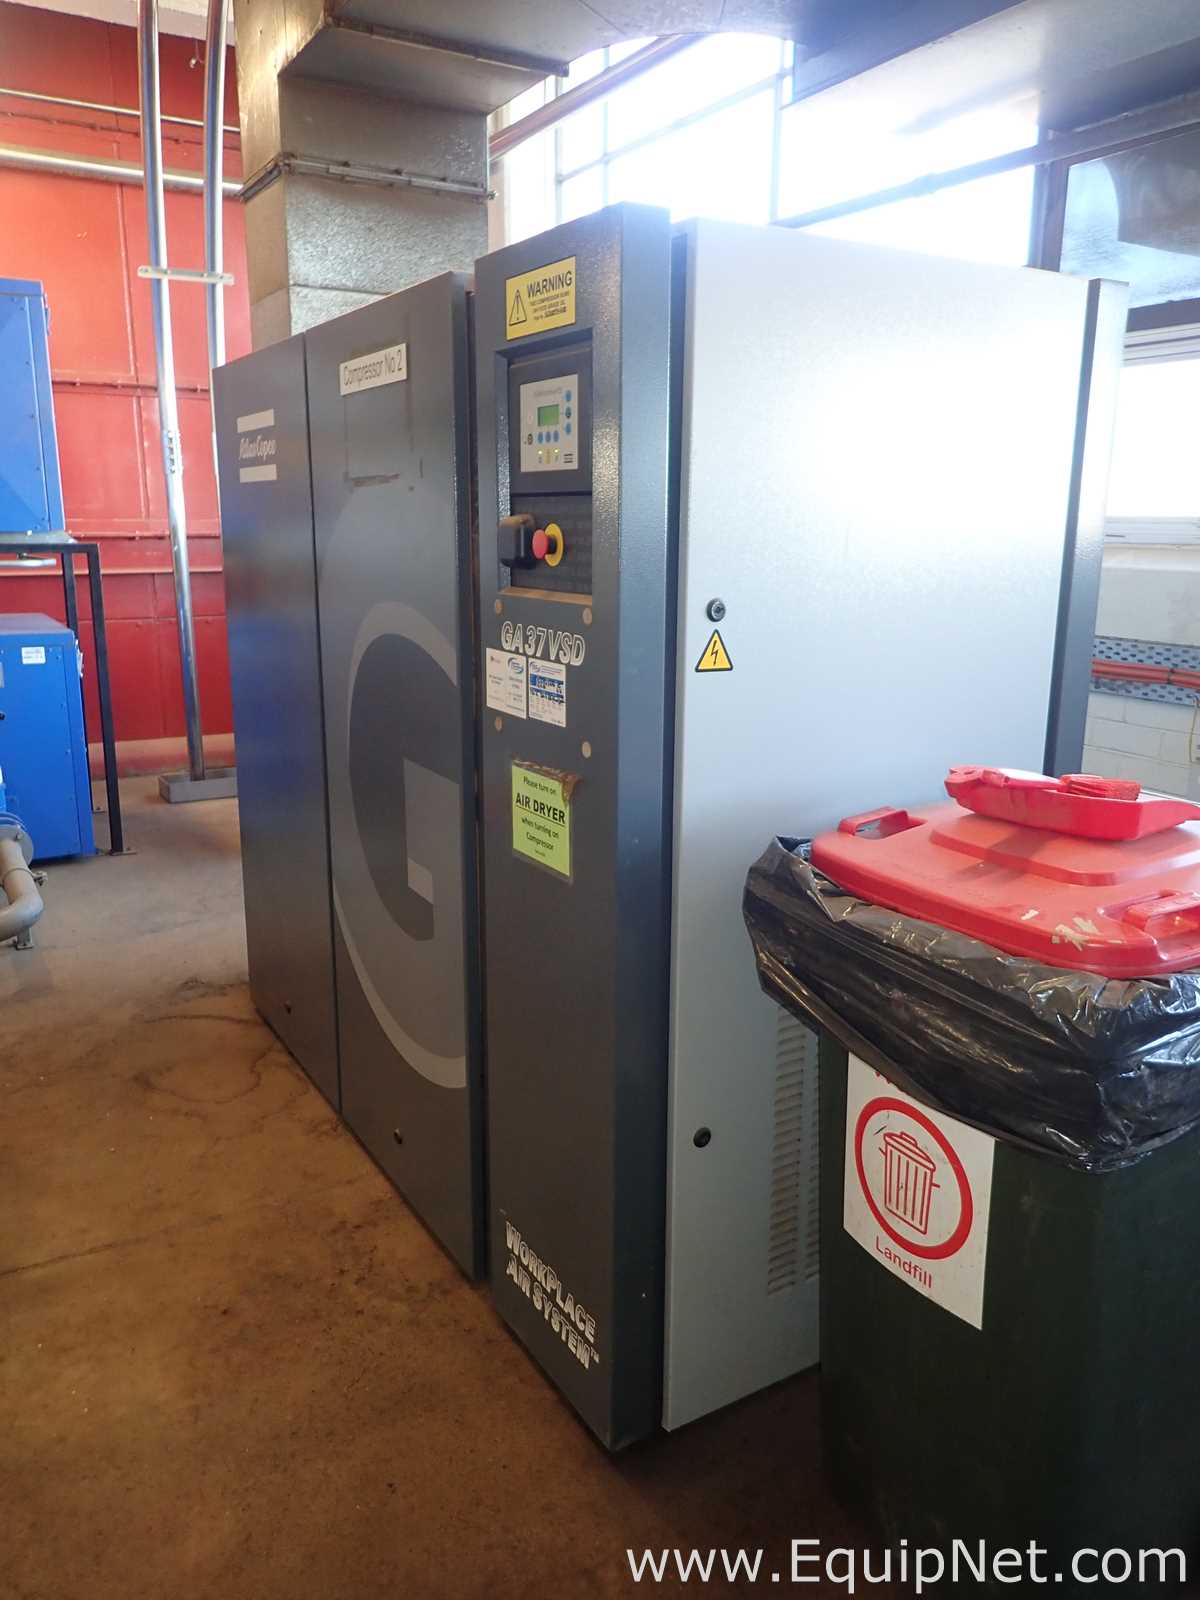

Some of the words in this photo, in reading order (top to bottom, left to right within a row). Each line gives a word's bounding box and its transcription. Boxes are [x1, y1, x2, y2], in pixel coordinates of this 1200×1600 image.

[527, 270, 573, 298] WARNING
[344, 360, 383, 386] Compressor
[549, 787, 557, 795] on
[515, 792, 531, 810] AIR
[532, 800, 565, 824] DRYER
[521, 817, 534, 828] when
[534, 821, 551, 838] turning
[551, 830, 560, 839] on
[526, 831, 554, 852] Compressor
[874, 1235, 933, 1289] Landfill
